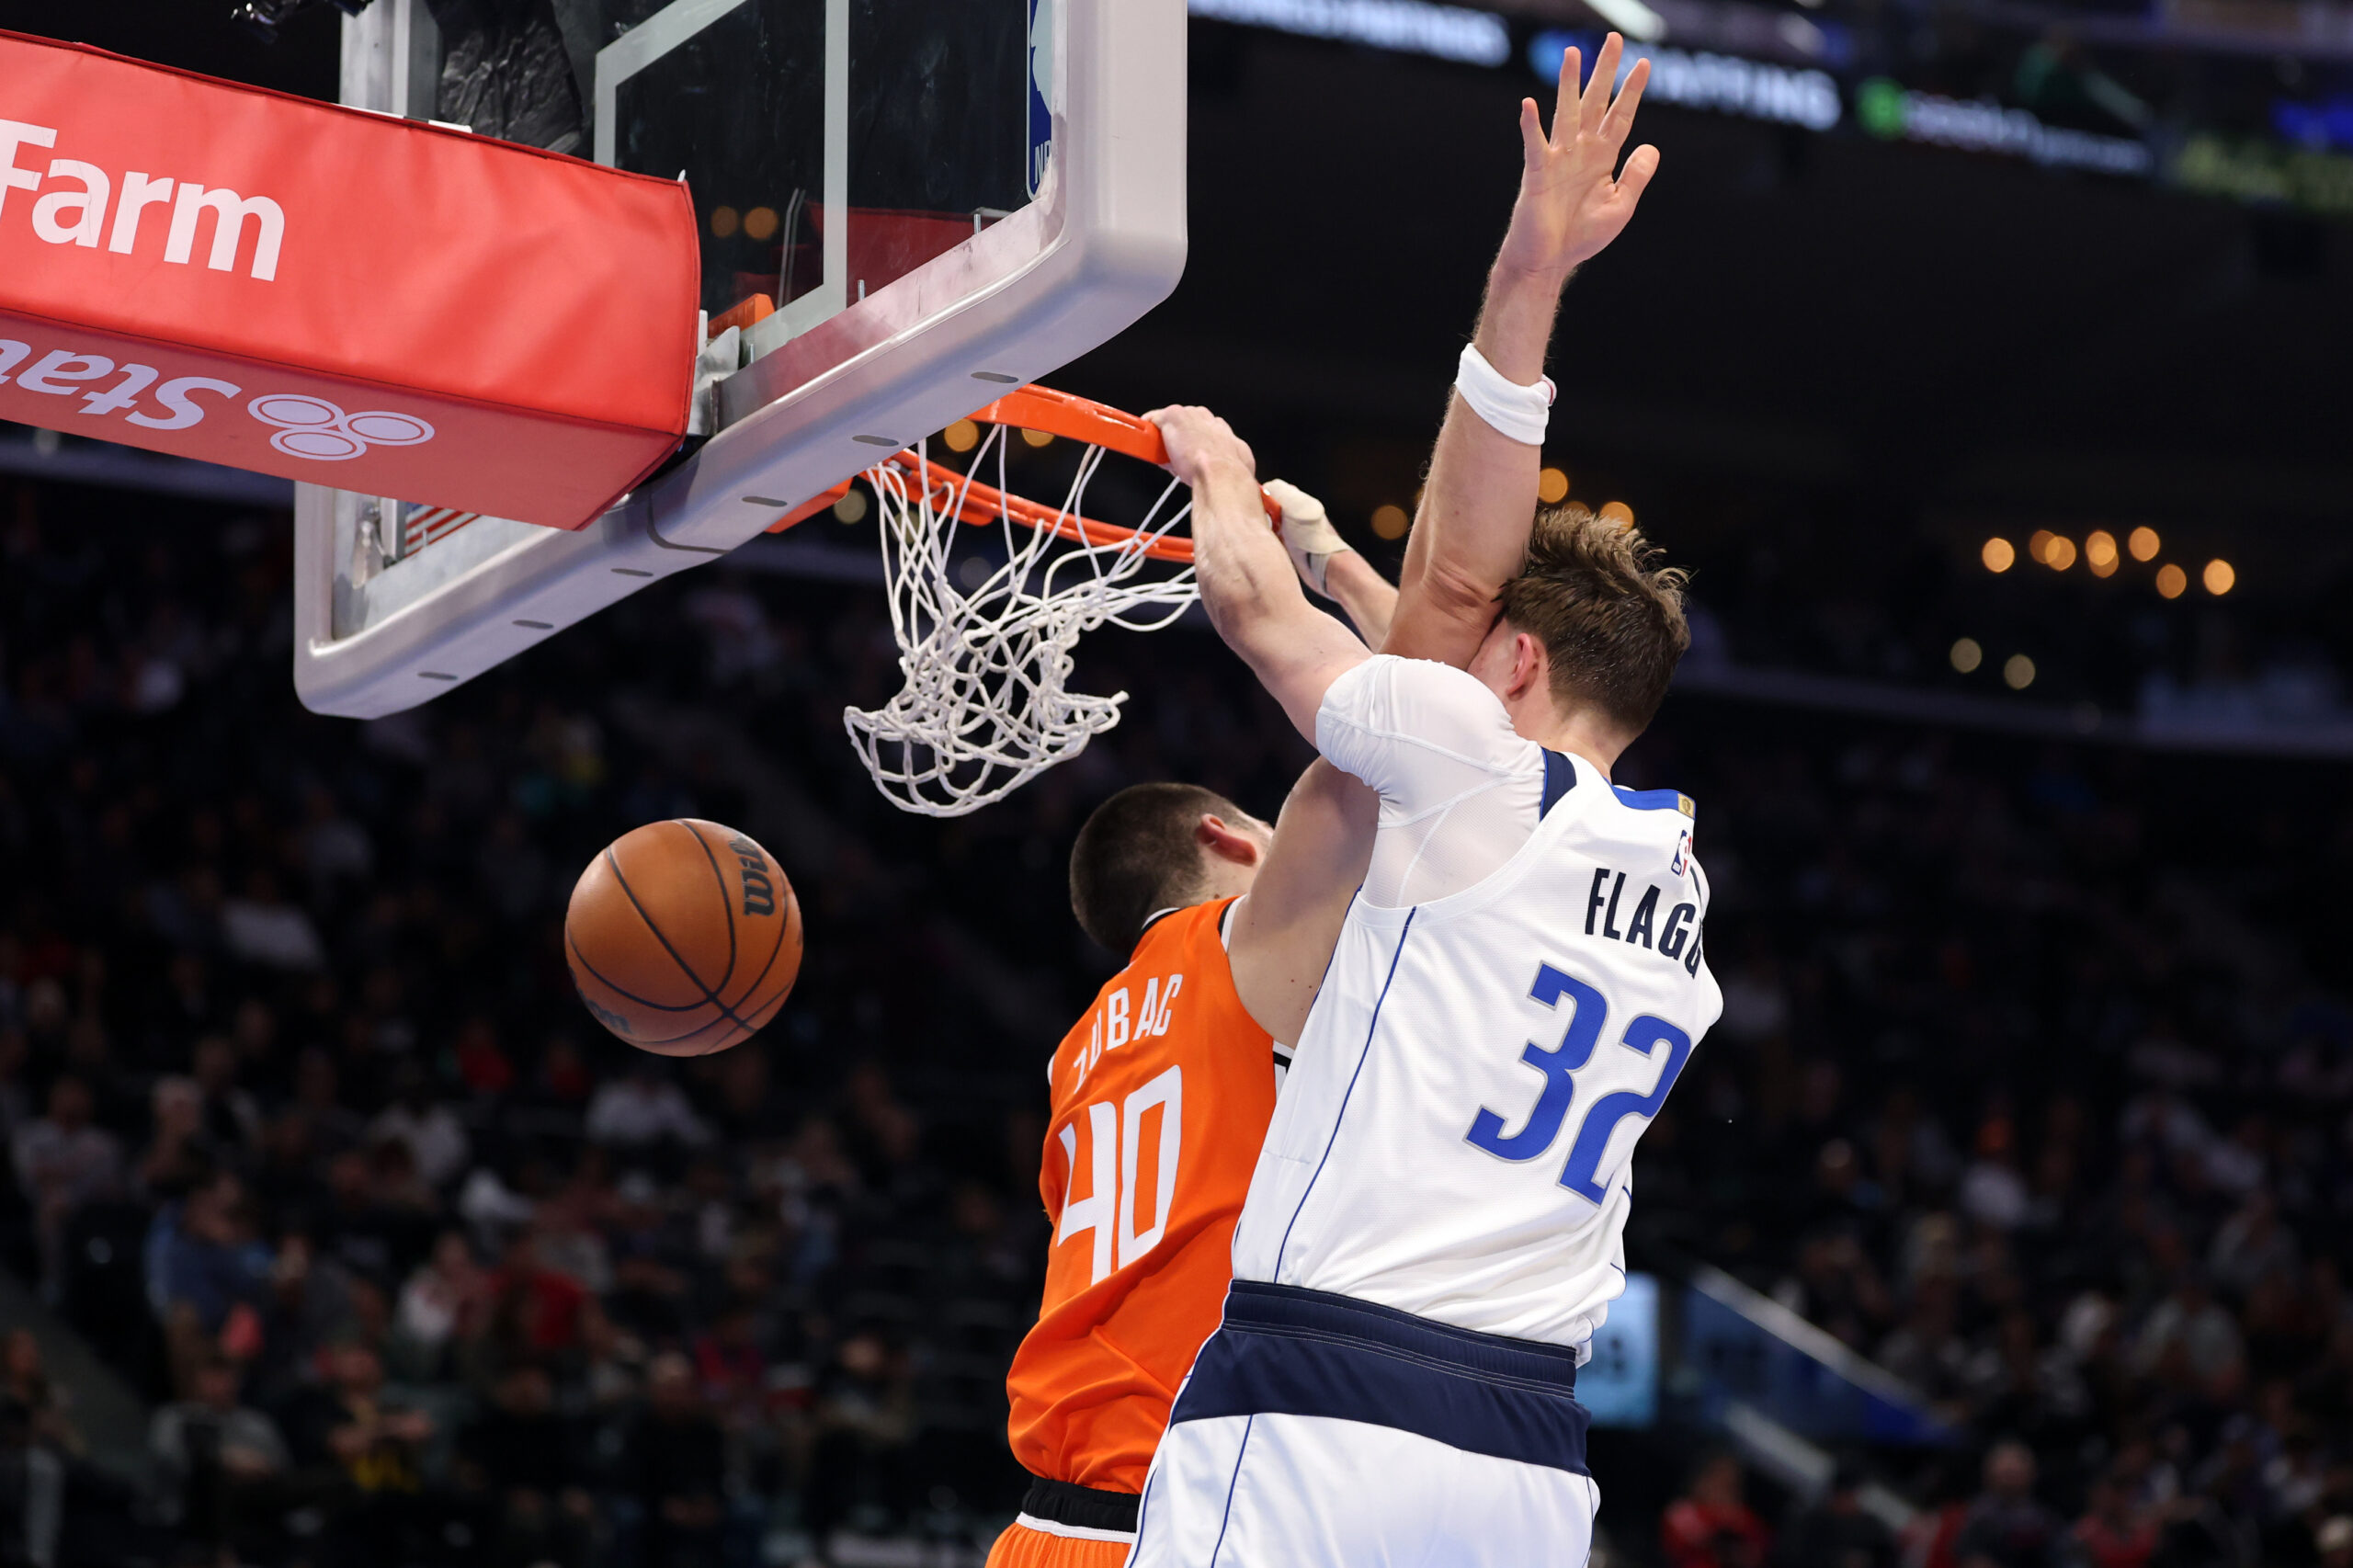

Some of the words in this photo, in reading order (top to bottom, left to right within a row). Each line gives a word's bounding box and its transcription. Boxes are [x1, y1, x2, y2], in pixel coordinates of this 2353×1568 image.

[0, 119, 285, 282] Farm
[1074, 973, 1184, 1095] ZUBAC
[1462, 960, 1691, 1210] 32
[1057, 1064, 1183, 1288] 40
